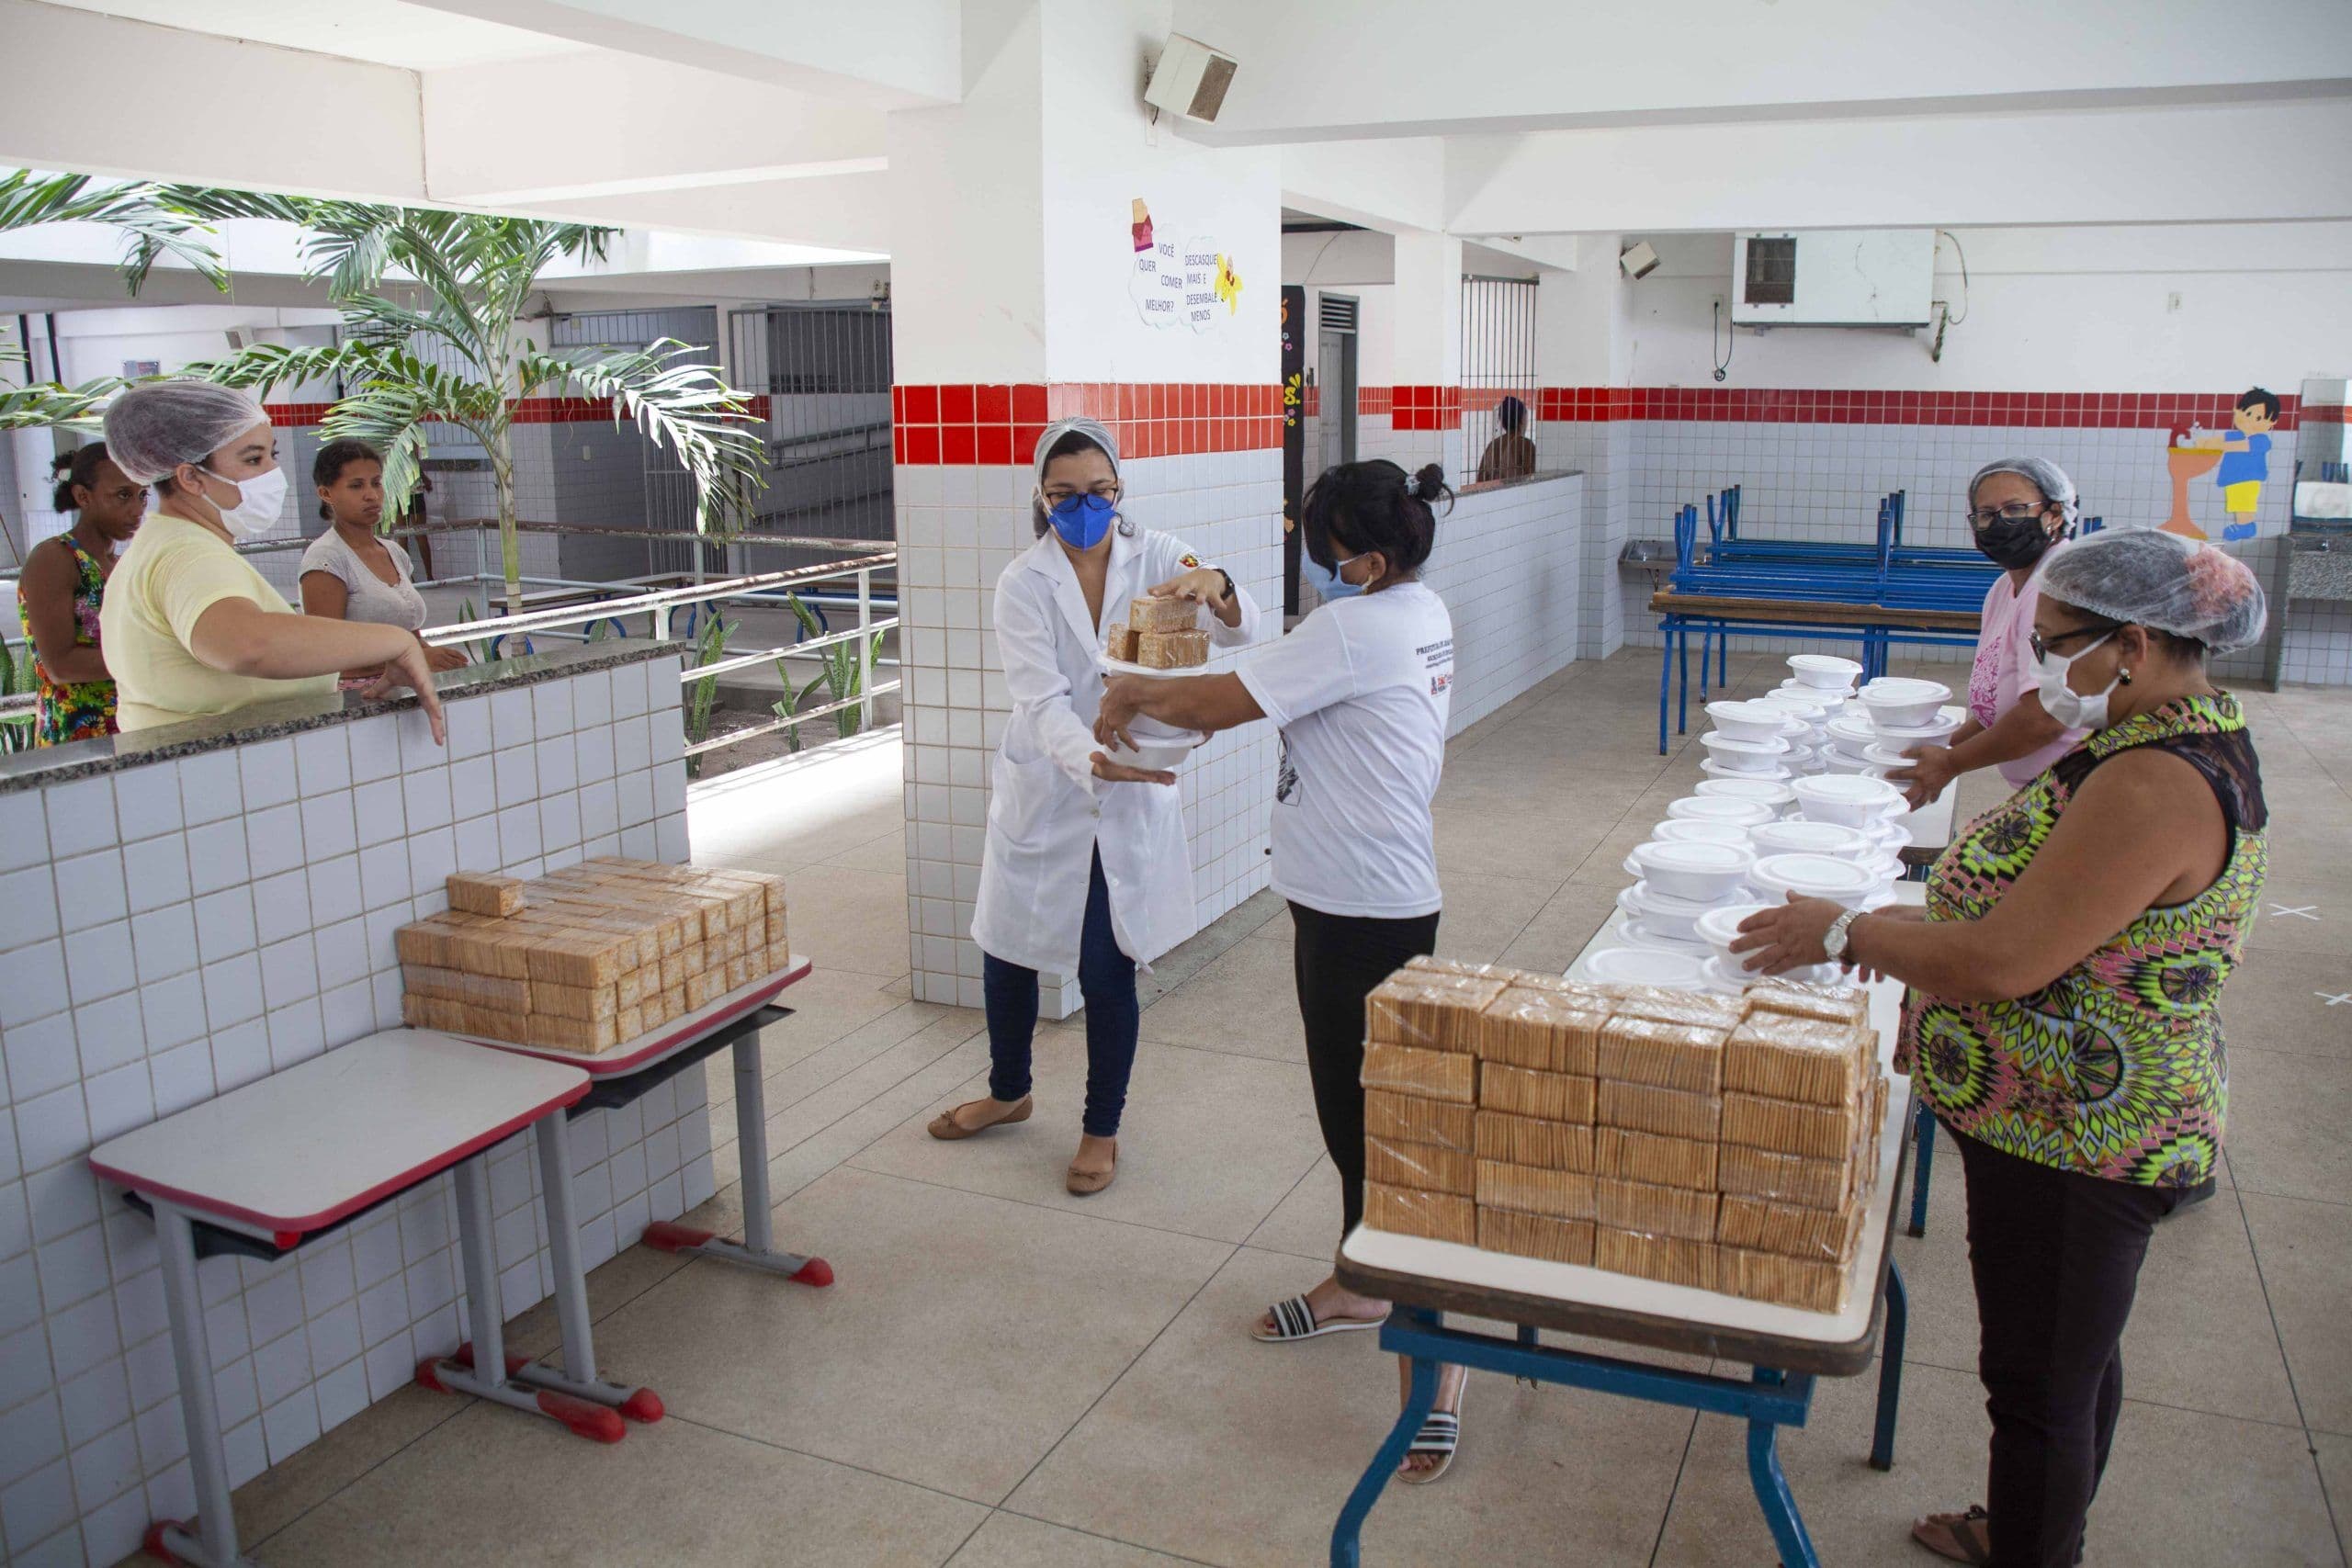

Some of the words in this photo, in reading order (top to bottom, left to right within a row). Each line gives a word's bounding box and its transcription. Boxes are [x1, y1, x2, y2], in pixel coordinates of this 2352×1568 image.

[1159, 243, 1174, 257] VOCÊ
[1139, 258, 1156, 272] QUER
[1185, 254, 1217, 266] DESCASQUE
[1160, 275, 1182, 289] COMER
[1187, 274, 1201, 285] MAIS
[1186, 292, 1217, 305] DESEMBALE
[1146, 299, 1174, 312] MELHOR?
[1191, 310, 1211, 321] MENOS
